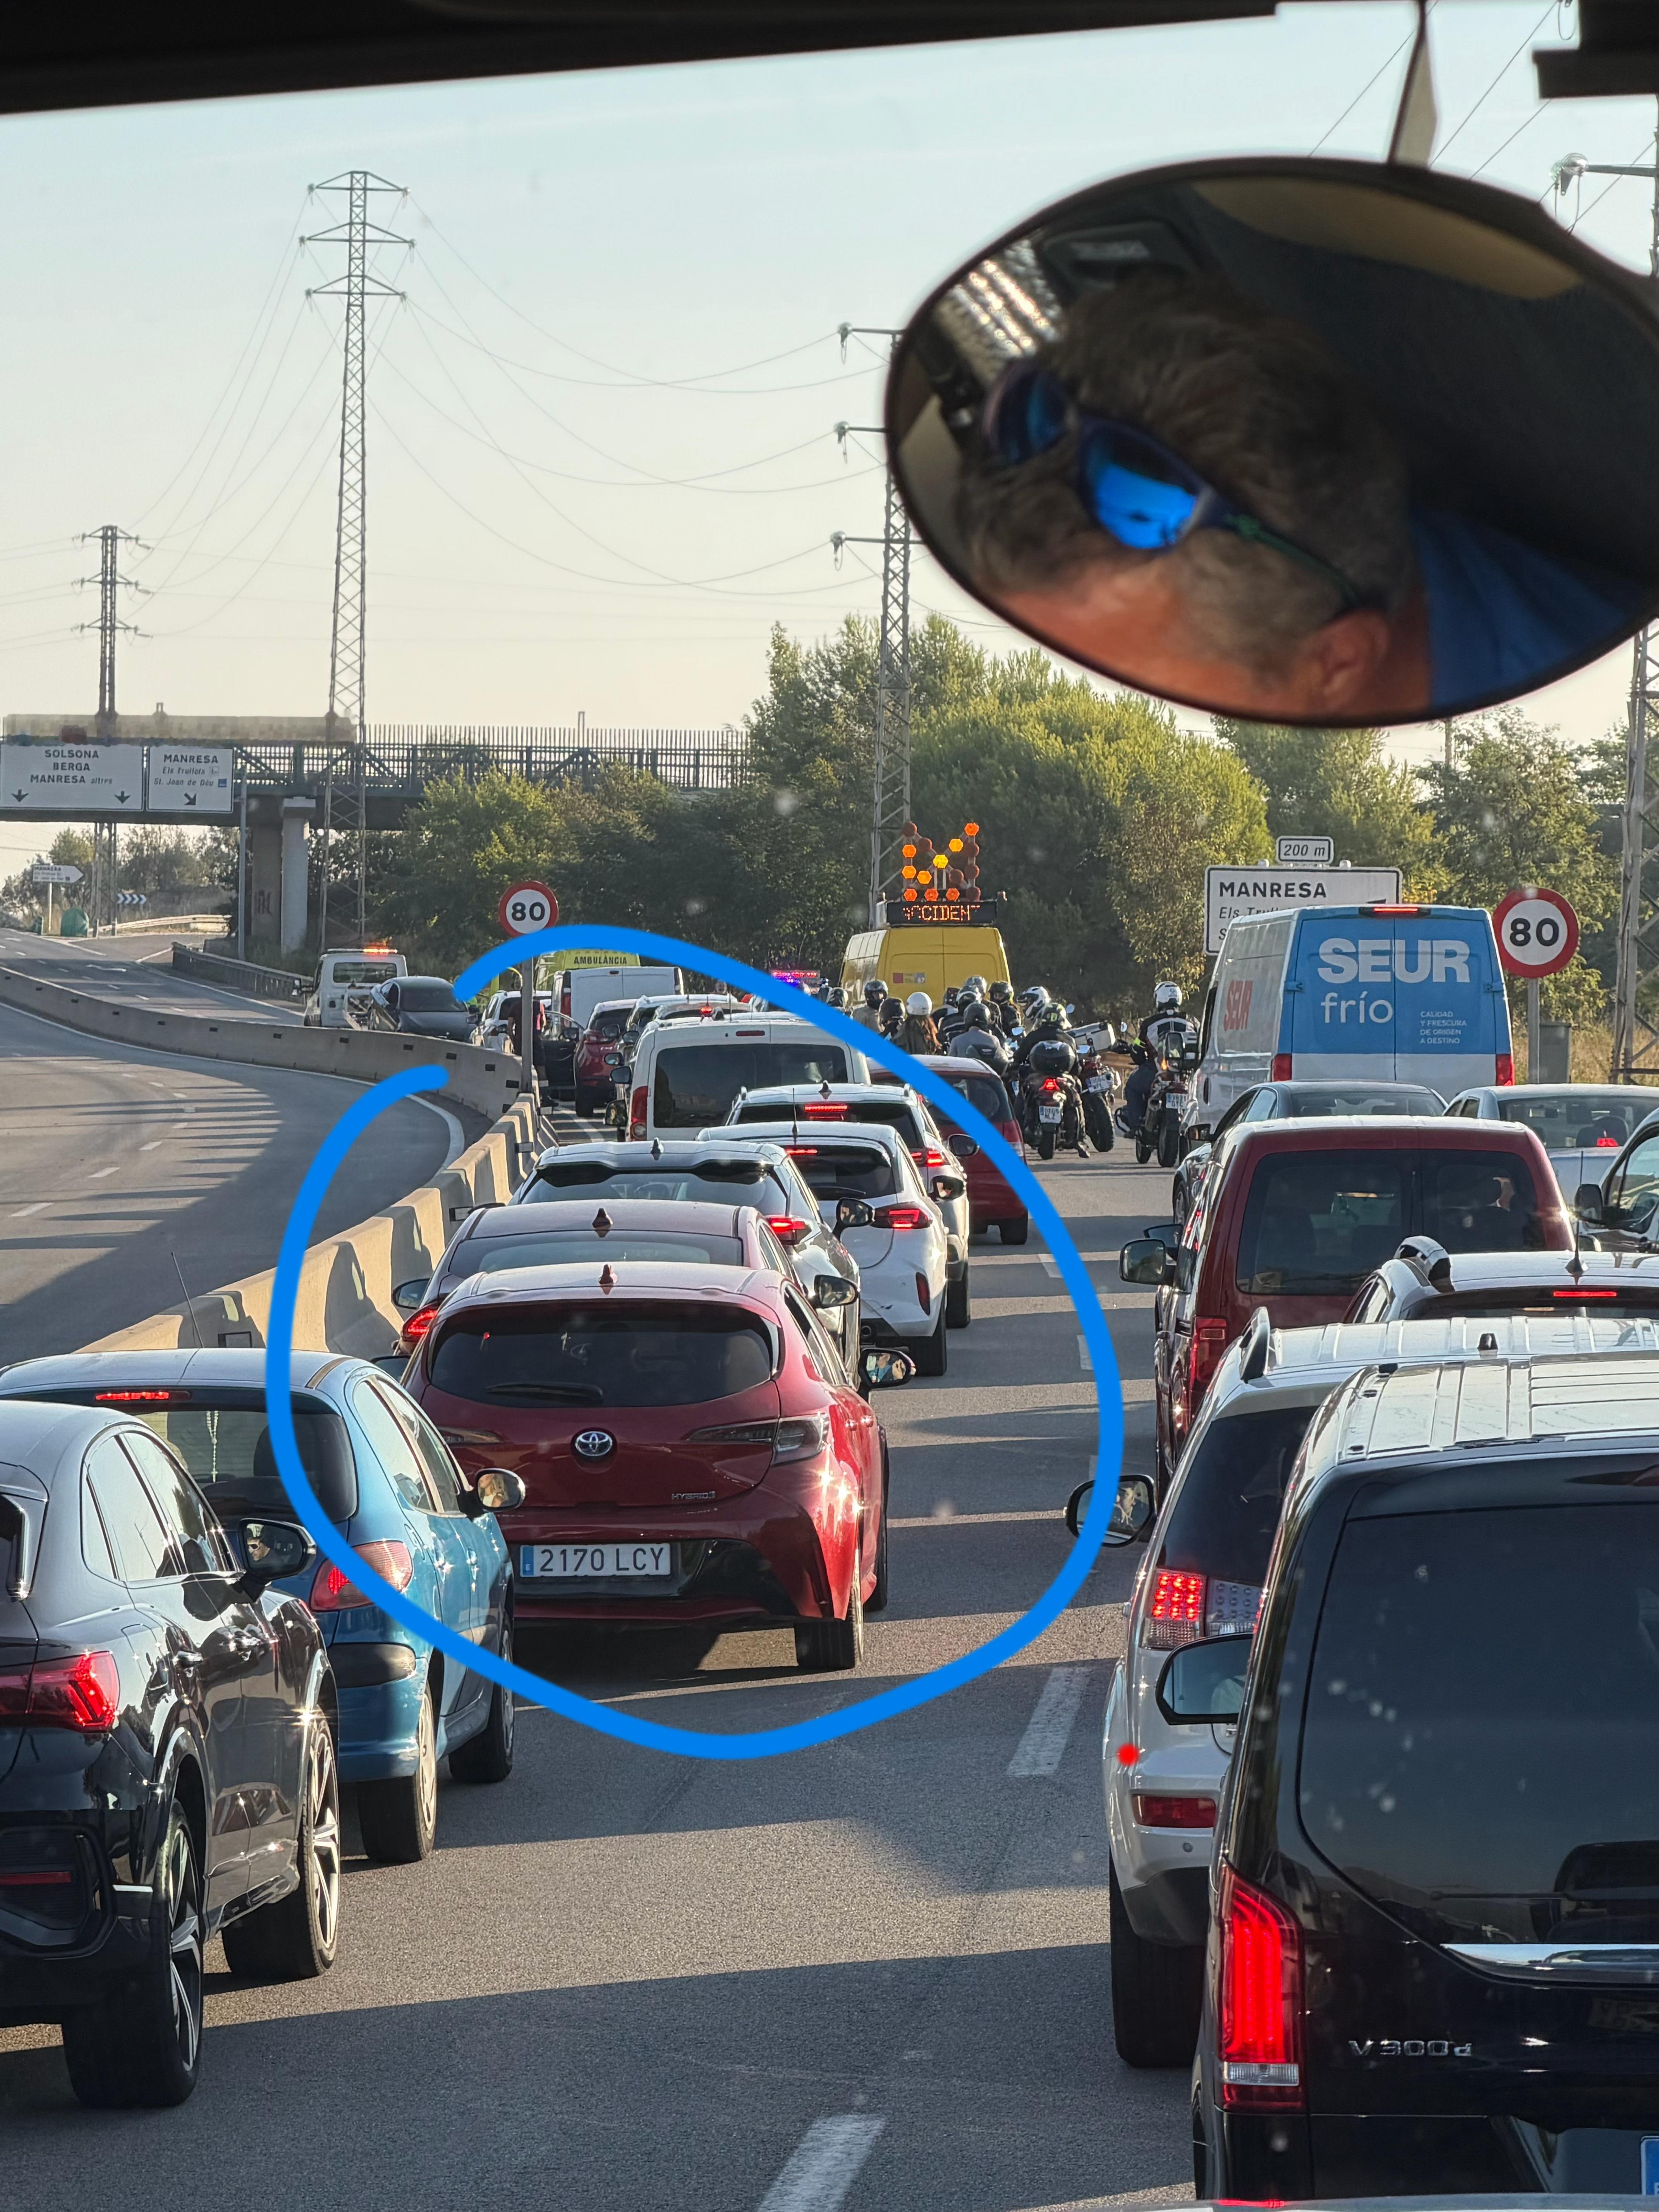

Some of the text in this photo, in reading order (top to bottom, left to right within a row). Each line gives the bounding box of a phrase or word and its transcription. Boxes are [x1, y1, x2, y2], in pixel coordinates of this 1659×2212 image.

[45, 749, 99, 759] SOLSONA
[164, 754, 218, 764] MANRESA
[53, 762, 91, 771] BERGA
[162, 766, 175, 775] Els
[30, 774, 86, 784] MANRESA
[1283, 844, 1326, 857] 200 m
[1219, 881, 1327, 898] MANRESA
[511, 902, 546, 922] 80
[1219, 907, 1240, 919] Els
[1509, 917, 1559, 947] 80
[1317, 937, 1470, 984] SEUR
[1223, 980, 1253, 1031] SEUR
[1321, 991, 1393, 1024] frío
[539, 1547, 664, 1572] 2170 LCY
